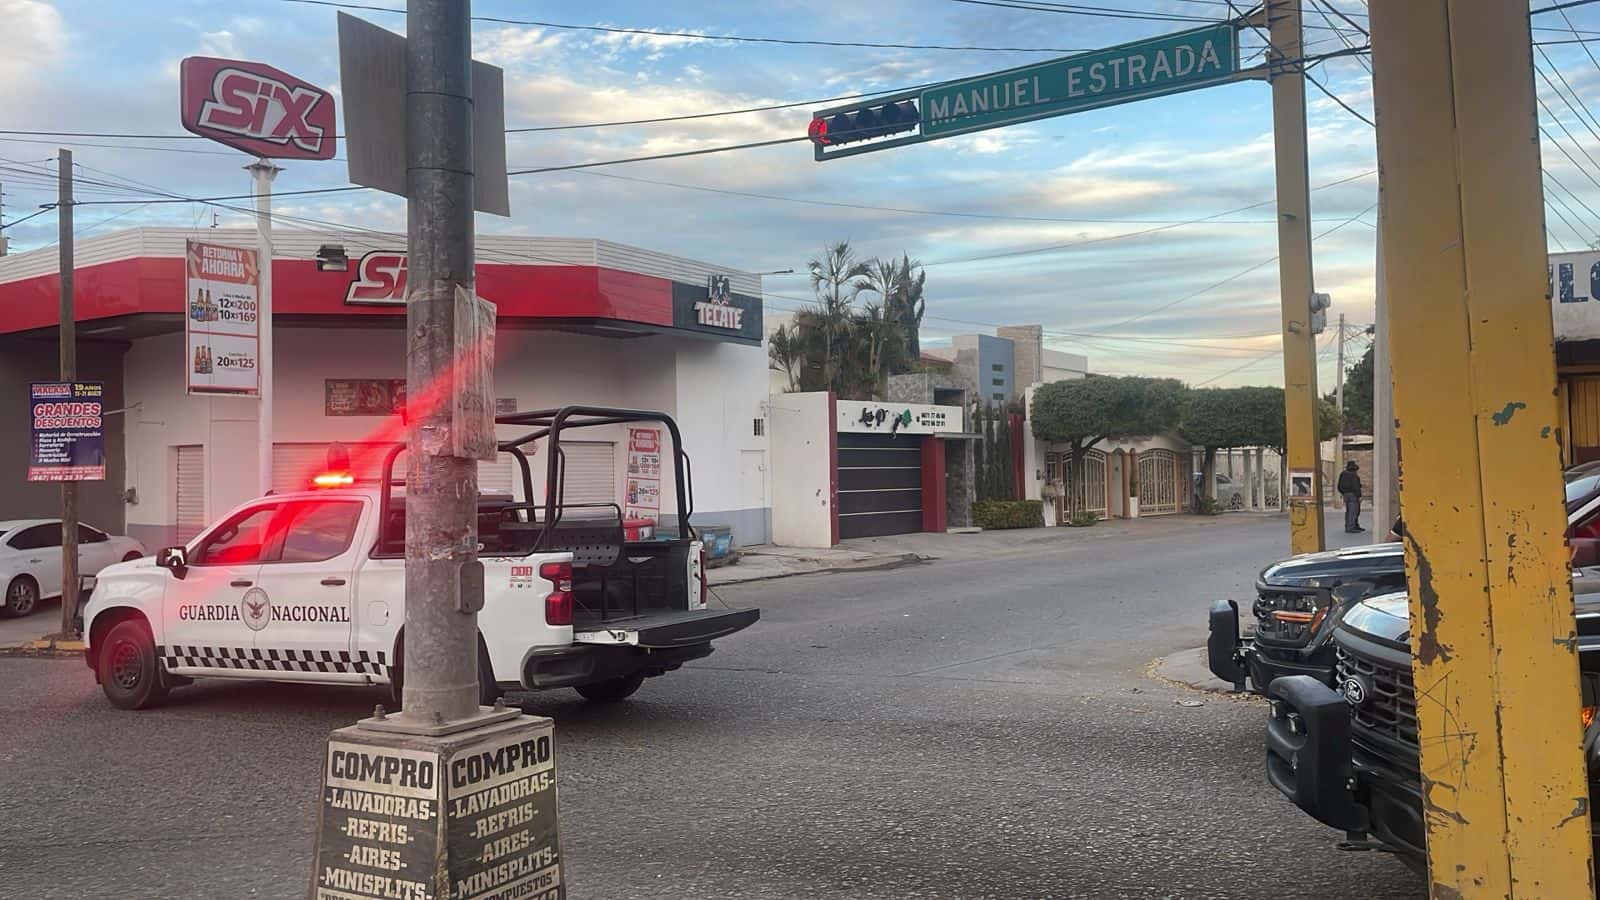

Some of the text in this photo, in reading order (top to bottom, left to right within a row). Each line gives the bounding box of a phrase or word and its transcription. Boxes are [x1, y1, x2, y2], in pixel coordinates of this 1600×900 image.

[930, 39, 1221, 126] MANUEL ESTRADA
[201, 259, 245, 279] AHORRA
[694, 301, 744, 330] TECATE
[34, 402, 102, 417] GRANDES
[34, 416, 102, 429] DESCUENTOS
[179, 604, 350, 622] GUARDIA NACIONAL
[331, 750, 434, 790] COMPRO
[451, 735, 550, 789] COMPRO
